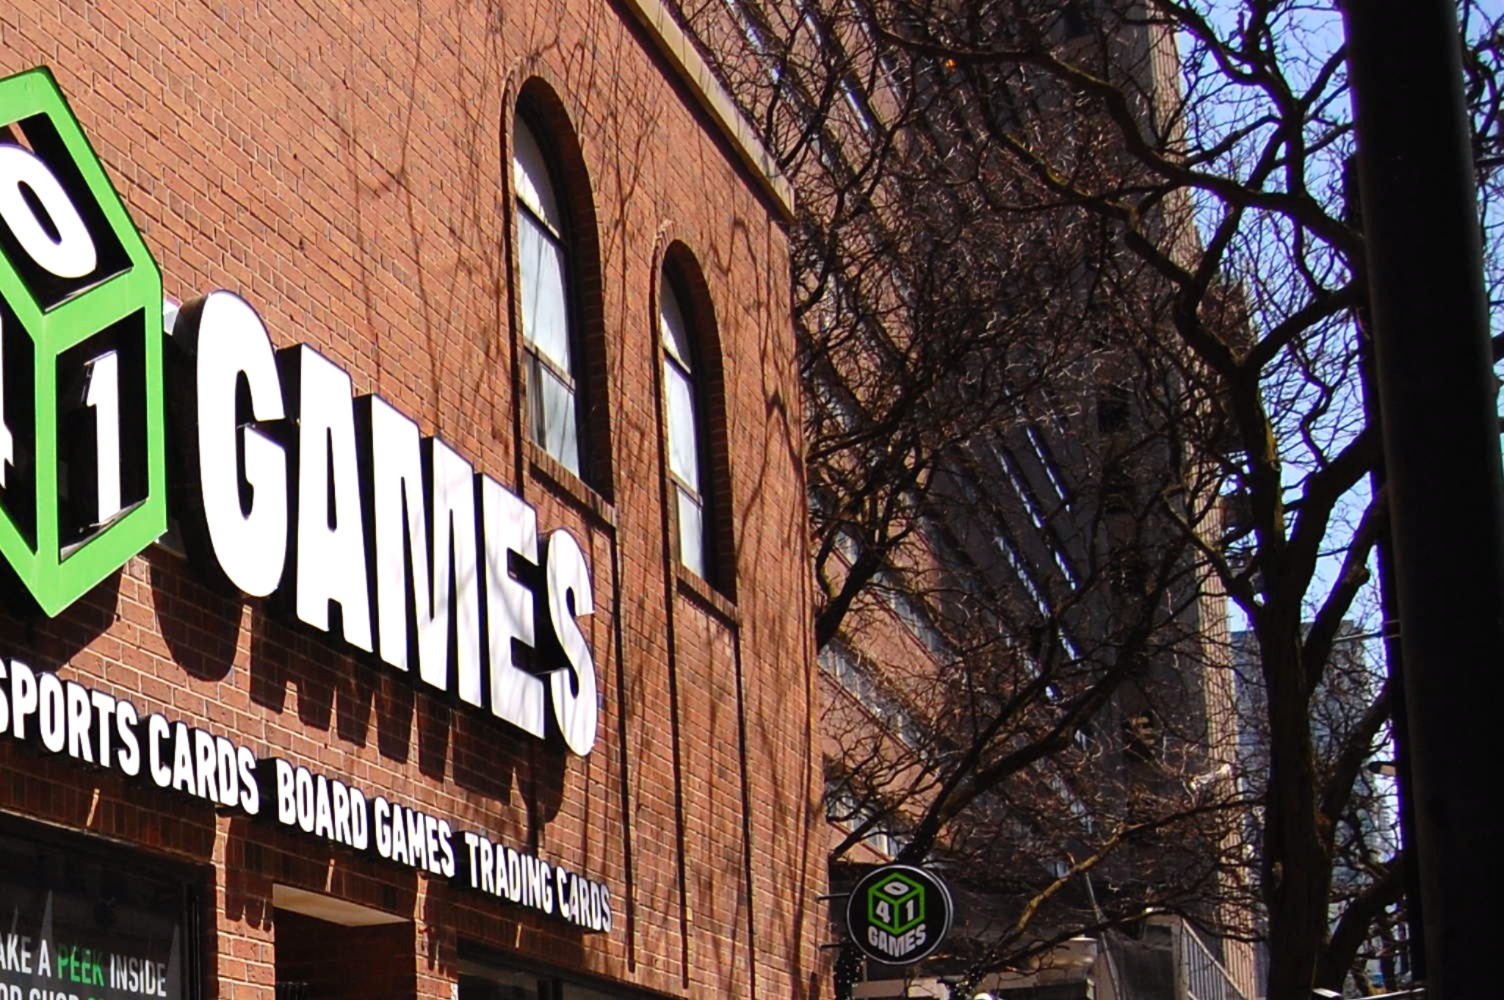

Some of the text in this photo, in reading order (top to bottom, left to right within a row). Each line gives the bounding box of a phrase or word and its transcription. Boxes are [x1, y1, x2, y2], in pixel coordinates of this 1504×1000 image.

[197, 290, 597, 757] GAMES
[148, 713, 261, 816] CARDS
[277, 760, 369, 849] BOARD
[374, 798, 456, 880] GAMES
[464, 839, 553, 916] TRADING
[555, 872, 613, 935] CARDS
[38, 939, 52, 978] A
[56, 943, 105, 987] PEEK
[110, 953, 167, 998] INSIDE
[867, 923, 928, 959] GAMES
